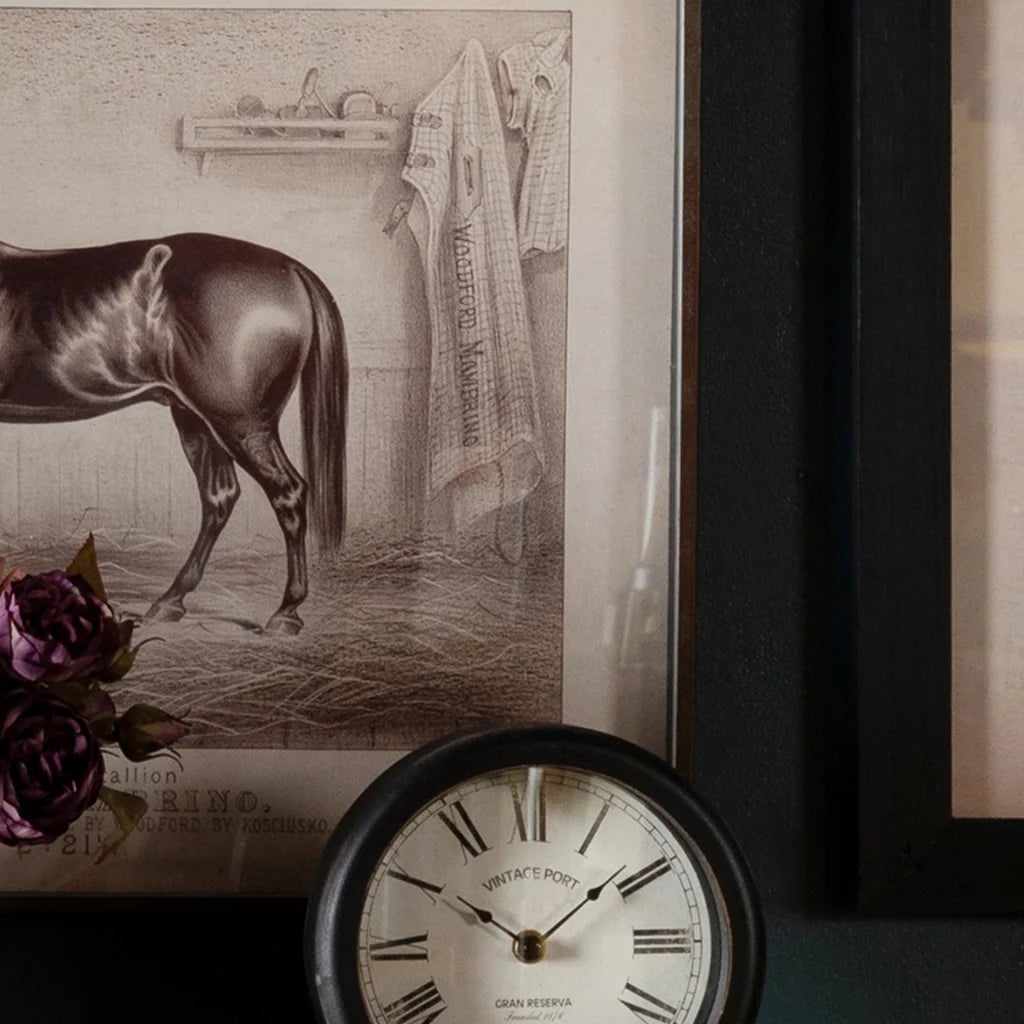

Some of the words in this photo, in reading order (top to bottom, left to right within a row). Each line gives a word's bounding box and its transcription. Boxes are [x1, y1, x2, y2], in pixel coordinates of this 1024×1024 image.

[453, 224, 477, 329] WOODFORD
[212, 817, 234, 833] BY
[481, 867, 542, 893] VINTAGE
[543, 868, 580, 890] PORT
[495, 998, 525, 1009] GRAN
[527, 997, 573, 1008] RESERVA
